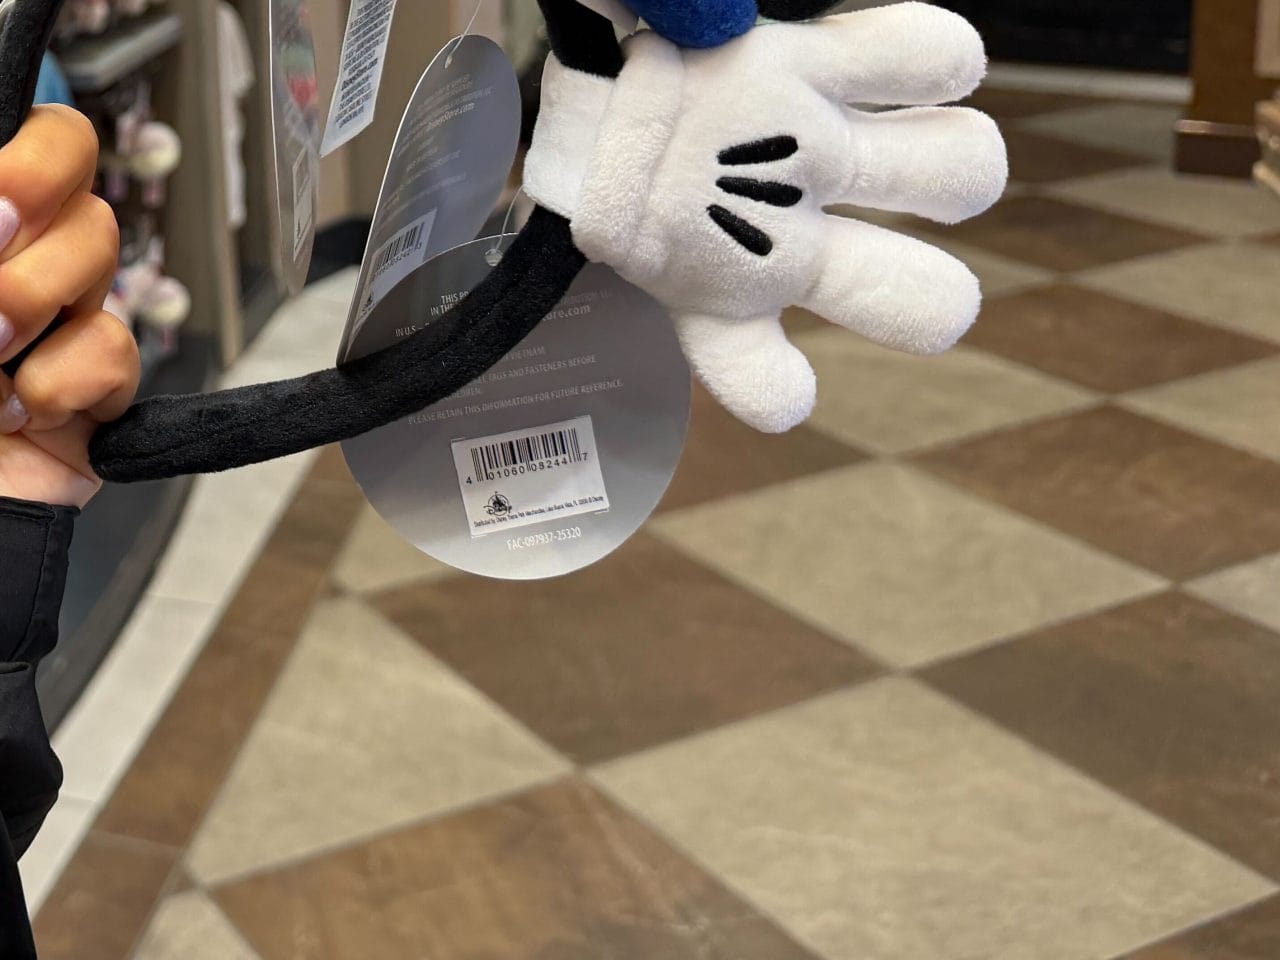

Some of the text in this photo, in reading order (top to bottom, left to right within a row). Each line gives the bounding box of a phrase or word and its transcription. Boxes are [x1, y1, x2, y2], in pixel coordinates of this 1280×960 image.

[440, 292, 458, 305] THIS
[429, 305, 439, 316] IN
[465, 451, 588, 485] 4 01060 08244 7
[506, 525, 581, 550] FAC-097937-25320
